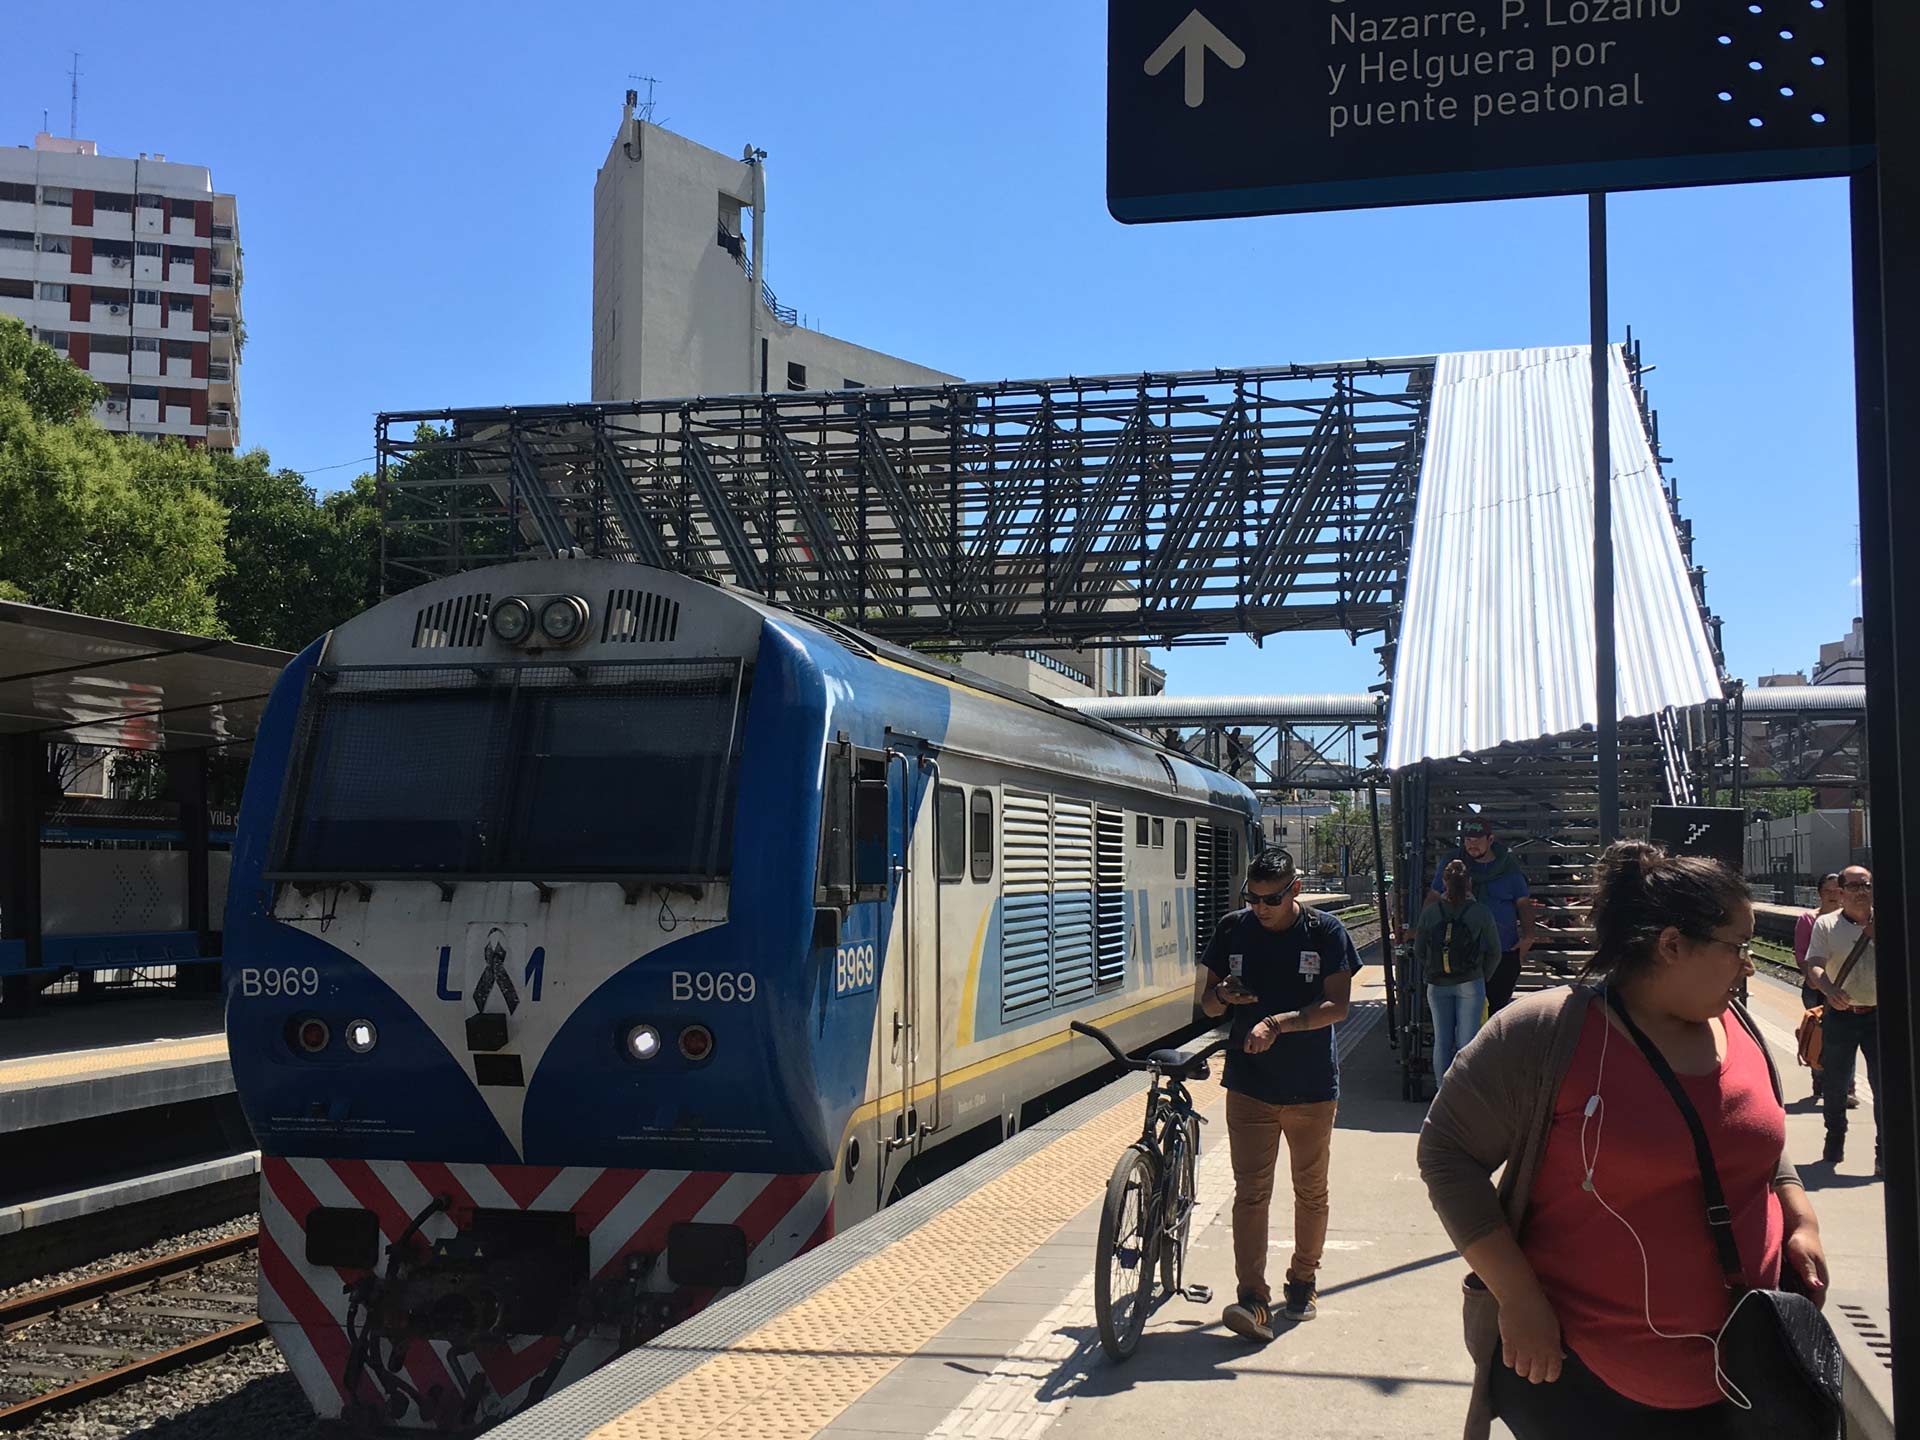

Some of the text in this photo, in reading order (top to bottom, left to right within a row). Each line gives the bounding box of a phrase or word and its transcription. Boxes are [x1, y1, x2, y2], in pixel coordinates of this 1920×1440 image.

[1330, 0, 1682, 45] Nazarre, P. Lozano
[1328, 40, 1616, 95] y Helguera por
[1329, 73, 1644, 137] puente peatonal
[210, 810, 232, 825] Villa
[241, 967, 320, 996] B969
[672, 972, 757, 1002] B969
[837, 944, 874, 992] B969
